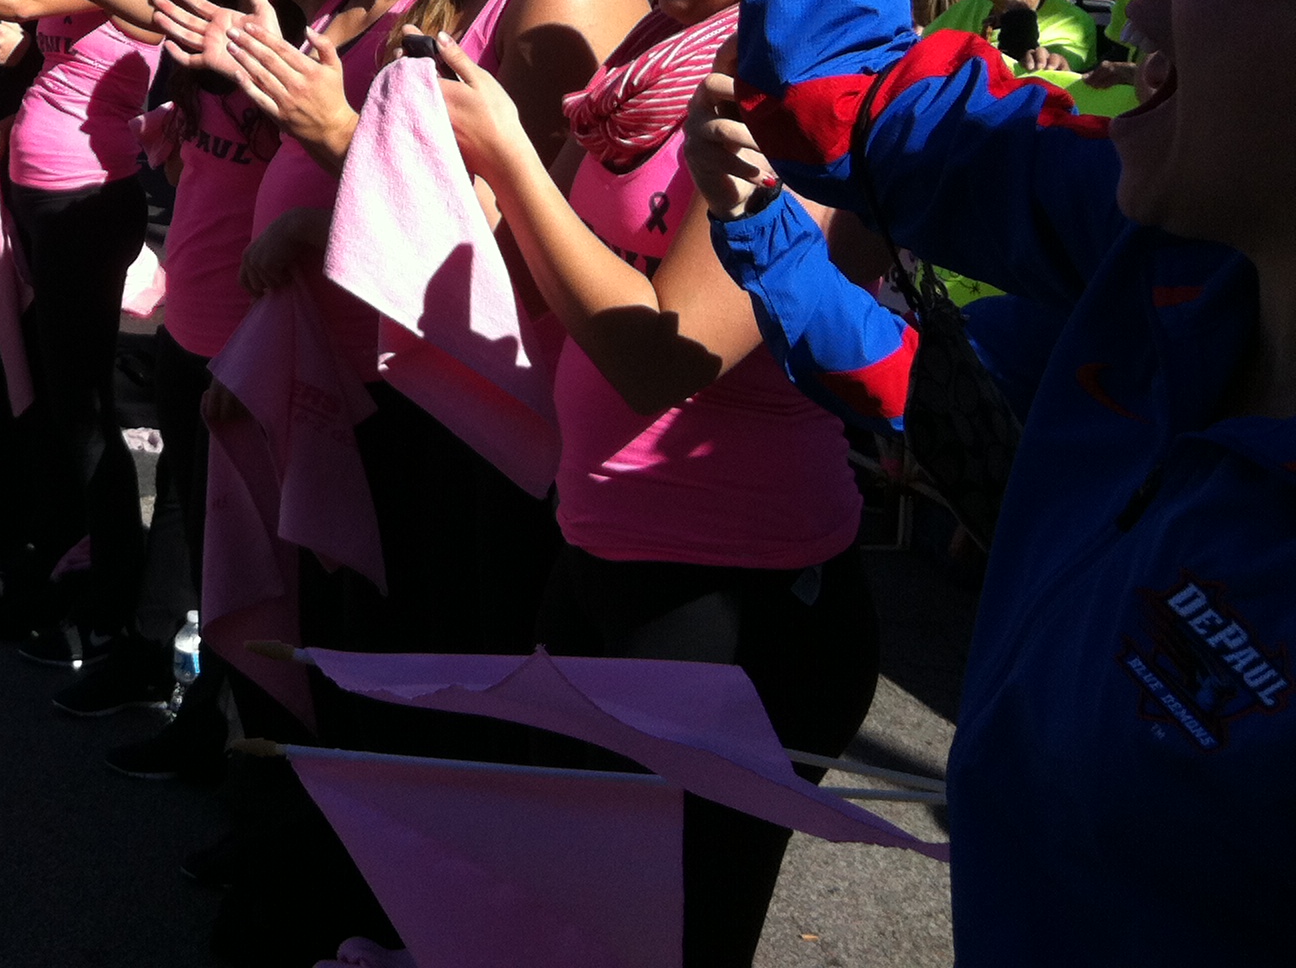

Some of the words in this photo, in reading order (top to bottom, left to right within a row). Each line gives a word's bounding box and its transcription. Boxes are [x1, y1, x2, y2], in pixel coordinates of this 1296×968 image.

[192, 130, 252, 164] AUL
[1126, 655, 1164, 691] BLUE
[1161, 693, 1217, 747] DEMONS
